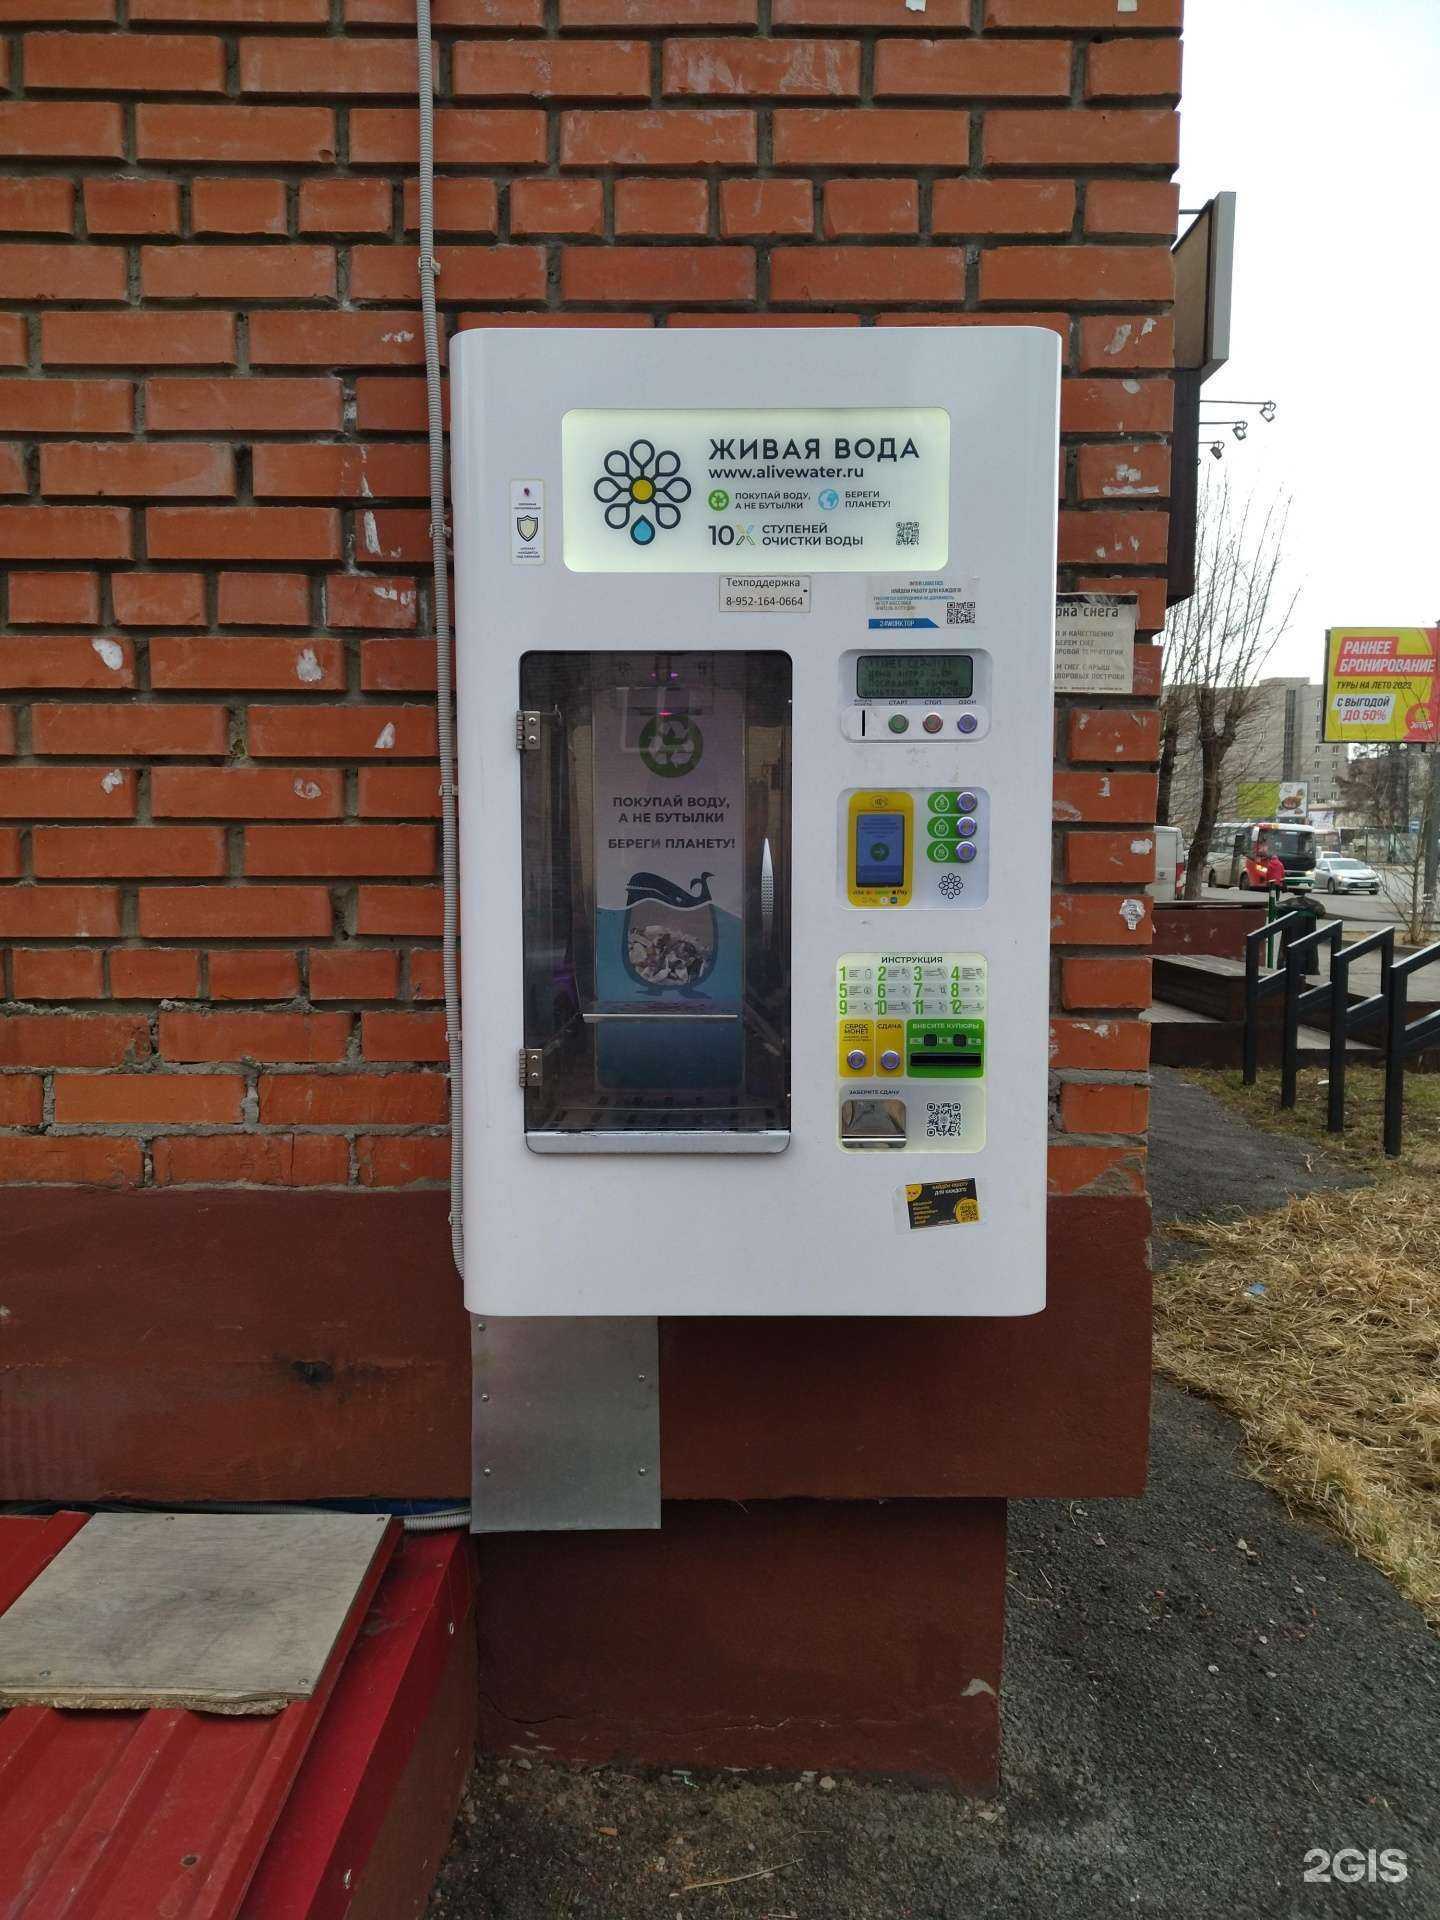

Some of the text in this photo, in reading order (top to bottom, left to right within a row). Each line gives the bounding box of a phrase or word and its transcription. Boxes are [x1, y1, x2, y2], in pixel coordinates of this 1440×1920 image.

[709, 438, 920, 463] ЖИВАЯ ВОДА
[709, 465, 864, 479] www.alivewater.ru
[735, 491, 811, 501] ПОКУПАЙ ВОДУ,
[735, 502, 742, 510] А
[845, 500, 891, 508] ПЛАНЕТУ!
[762, 522, 828, 534] СТУПЕНЕЙ
[762, 536, 864, 547] ОЧИСТКИ ВОДЫ
[726, 577, 800, 589] Техподдержка
[726, 596, 803, 606] 8-952-164-0664
[1083, 607, 1119, 617] снега
[1069, 630, 1114, 638] КАЧЕСТВЕННО
[1344, 640, 1393, 655] РАННЕЕ
[1339, 659, 1436, 673] БРОНИРОВАНИЕ
[1336, 681, 1359, 689] ТУРЫ
[1359, 681, 1370, 689] НА
[1371, 681, 1392, 689] ЛЕТО
[1337, 695, 1391, 708] С ВЫГОДОЙ
[1343, 710, 1360, 722] ДО
[612, 795, 730, 809] ПОКУПАЙ ВОДУ,
[618, 812, 724, 823] А НЕ БУТЫЛКИ
[608, 838, 736, 849] БЕРЕГИ ПЛАНЕТУ!
[881, 956, 943, 964] ИНСТРУКЦИЯ
[839, 966, 846, 981] 1
[878, 966, 886, 981] 2
[914, 966, 922, 981] 3
[951, 966, 960, 981] 4
[839, 983, 847, 998] 5
[878, 983, 886, 998] 6
[914, 983, 923, 998] 7
[951, 983, 959, 998] 8
[839, 1000, 847, 1015] 9
[875, 1000, 887, 1016] 10
[912, 1000, 924, 1015] 11
[949, 1000, 962, 1015] 12
